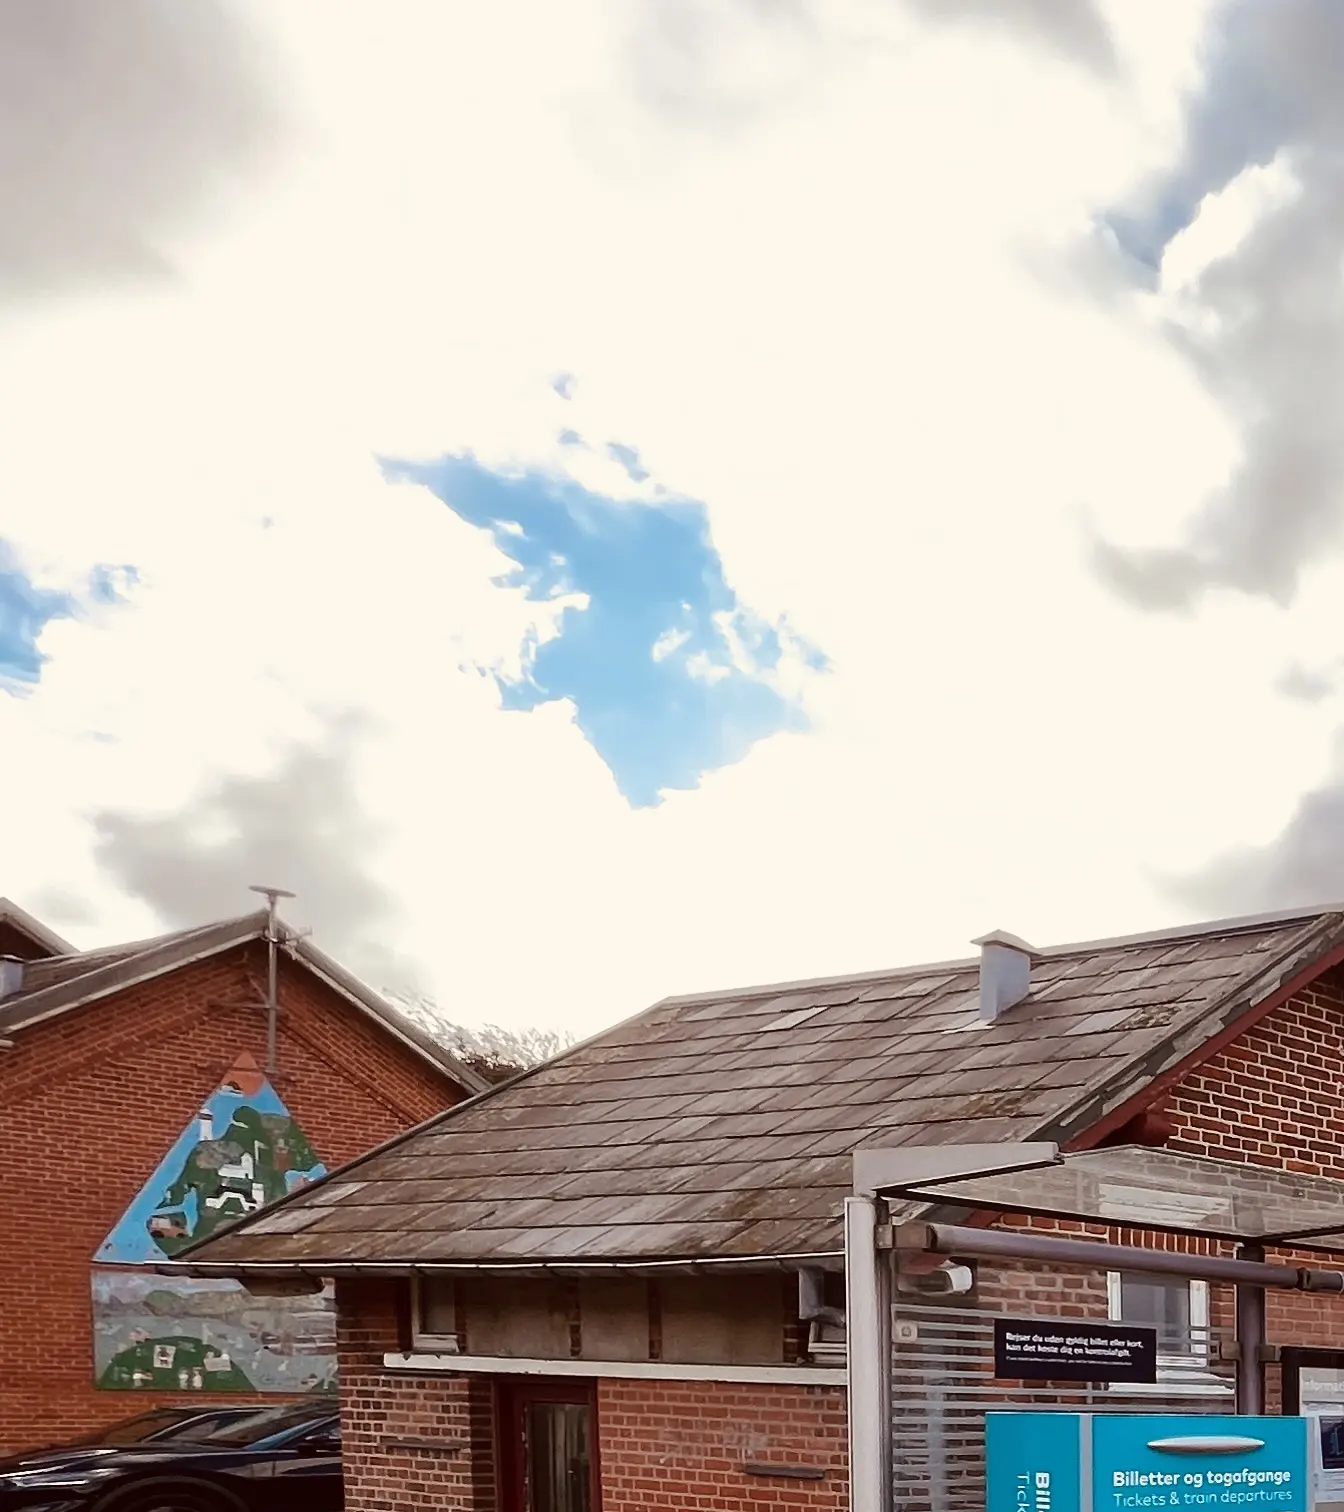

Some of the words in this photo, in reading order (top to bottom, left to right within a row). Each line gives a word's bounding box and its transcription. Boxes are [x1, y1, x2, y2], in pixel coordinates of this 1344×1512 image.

[1032, 1334, 1043, 1342] du
[1005, 1343, 1022, 1351] kan
[1112, 1471, 1180, 1487] Billetter
[1183, 1473, 1203, 1488] og
[1206, 1468, 1291, 1486] togafgange
[1113, 1493, 1166, 1507] Tickets
[1169, 1491, 1180, 1505] &
[1184, 1491, 1217, 1504] train
[1220, 1489, 1292, 1505] departures
